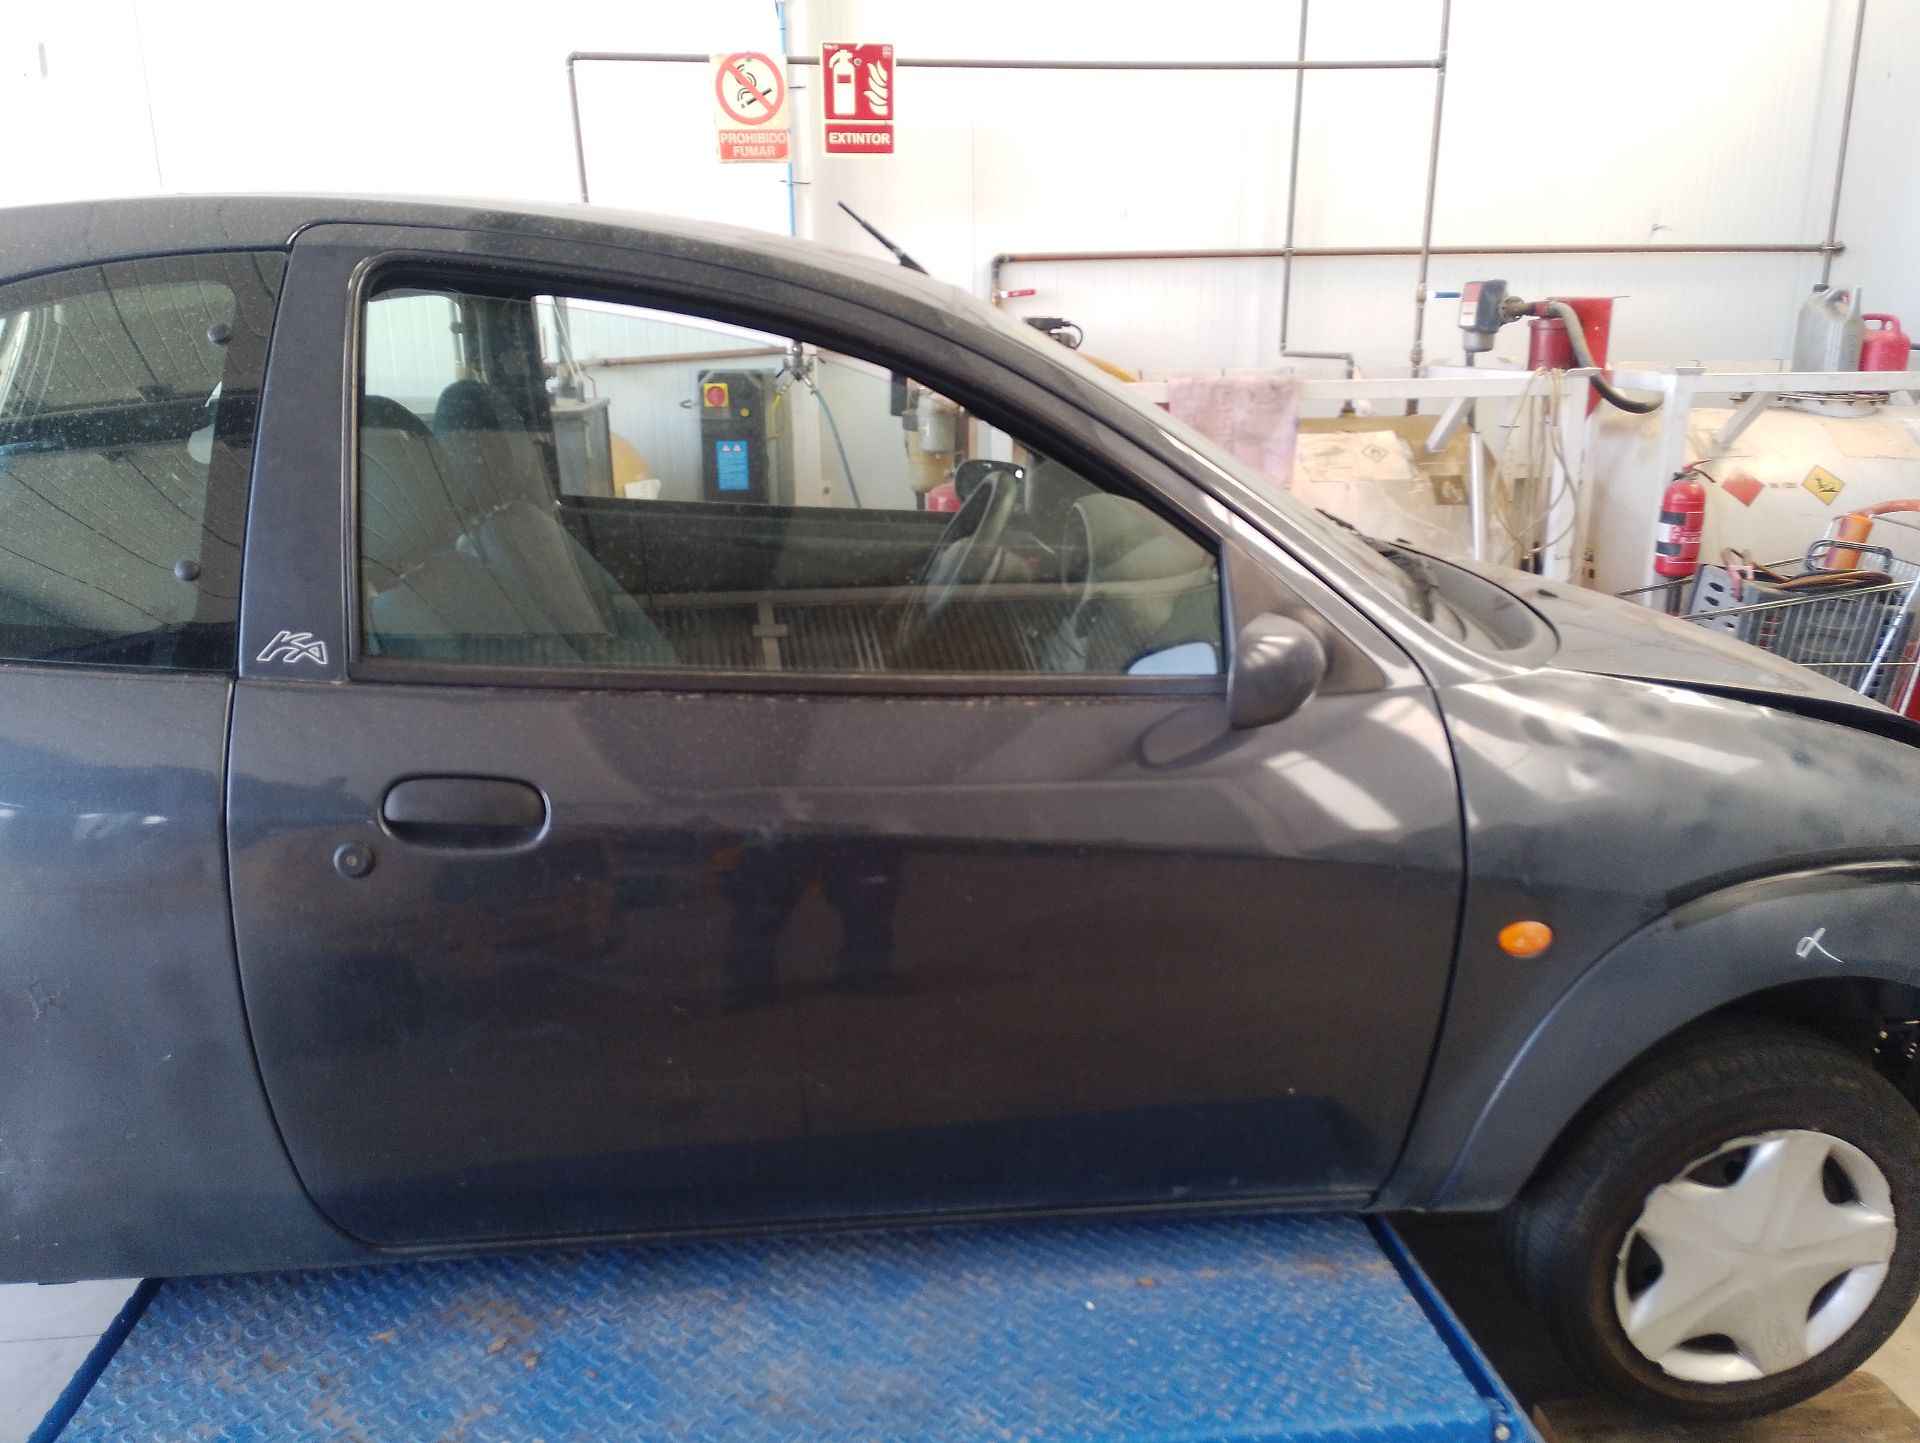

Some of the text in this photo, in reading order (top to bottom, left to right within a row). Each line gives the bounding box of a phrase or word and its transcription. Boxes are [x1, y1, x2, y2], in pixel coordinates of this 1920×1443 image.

[720, 132, 786, 144] PROHIBIDO
[829, 132, 890, 145] EXTINTOR
[733, 145, 776, 156] FUMAR
